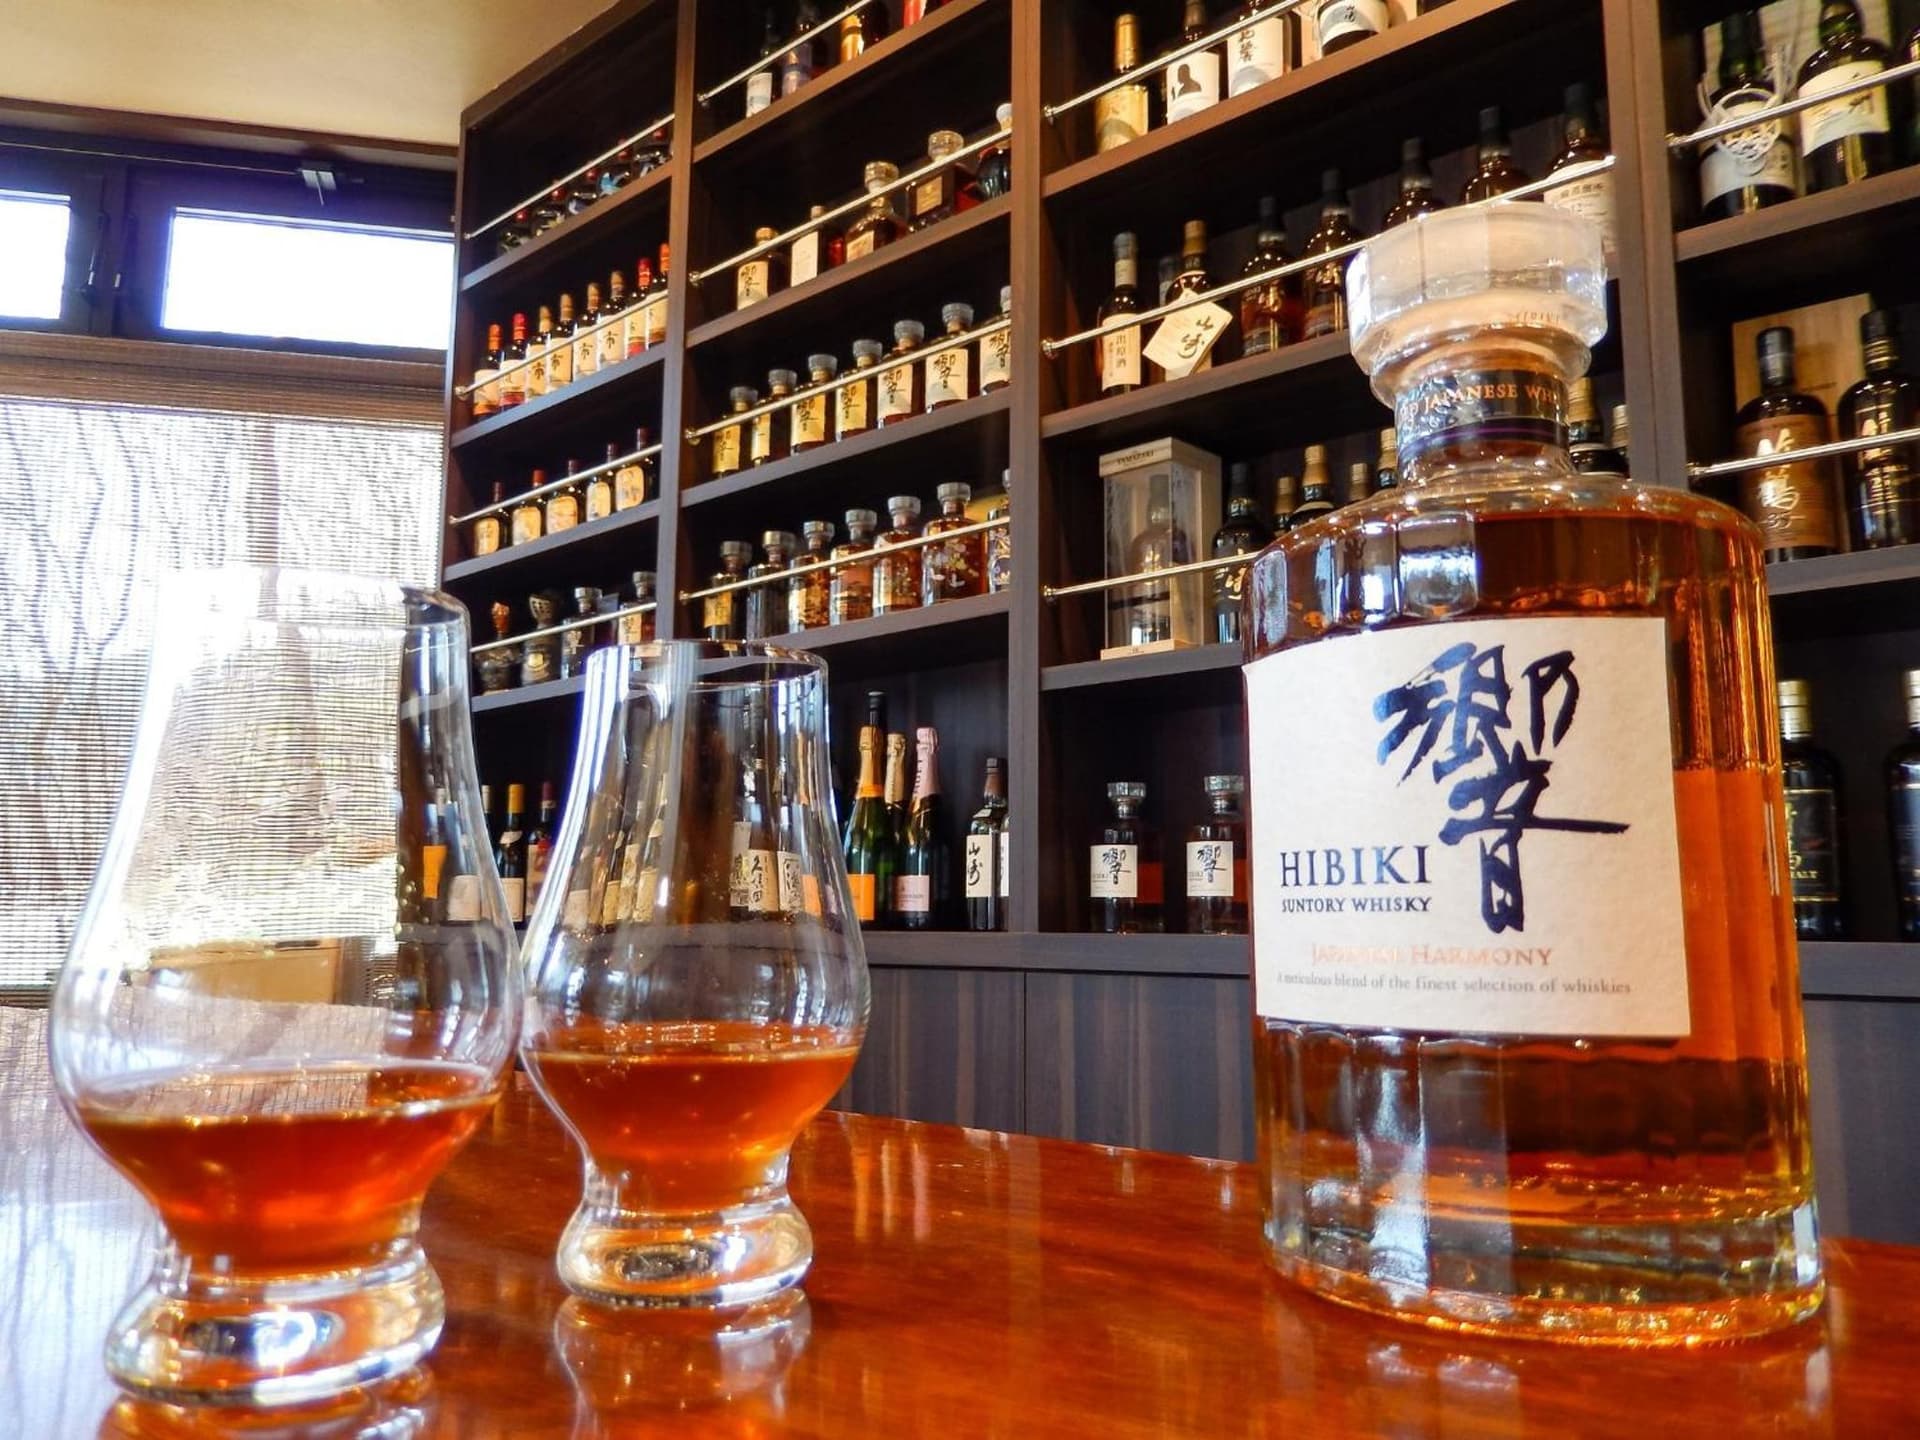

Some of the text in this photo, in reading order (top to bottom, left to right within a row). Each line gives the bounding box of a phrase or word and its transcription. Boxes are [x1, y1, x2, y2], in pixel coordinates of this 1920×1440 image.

[1424, 383, 1519, 415] JAPANESE
[1372, 641, 1632, 935] 響
[1102, 847, 1132, 885] 響
[1197, 844, 1228, 884] 響
[1280, 844, 1433, 888] HIBIKI
[1281, 896, 1433, 914] SUNTORY WHISKY
[1411, 942, 1553, 968] HARMONY
[1334, 972, 1367, 988] blend
[1370, 974, 1384, 990] of
[1388, 975, 1411, 990] the
[1415, 975, 1457, 992] finest
[1462, 976, 1535, 993] selection
[1539, 976, 1558, 993] of
[1561, 976, 1632, 995] whiskies
